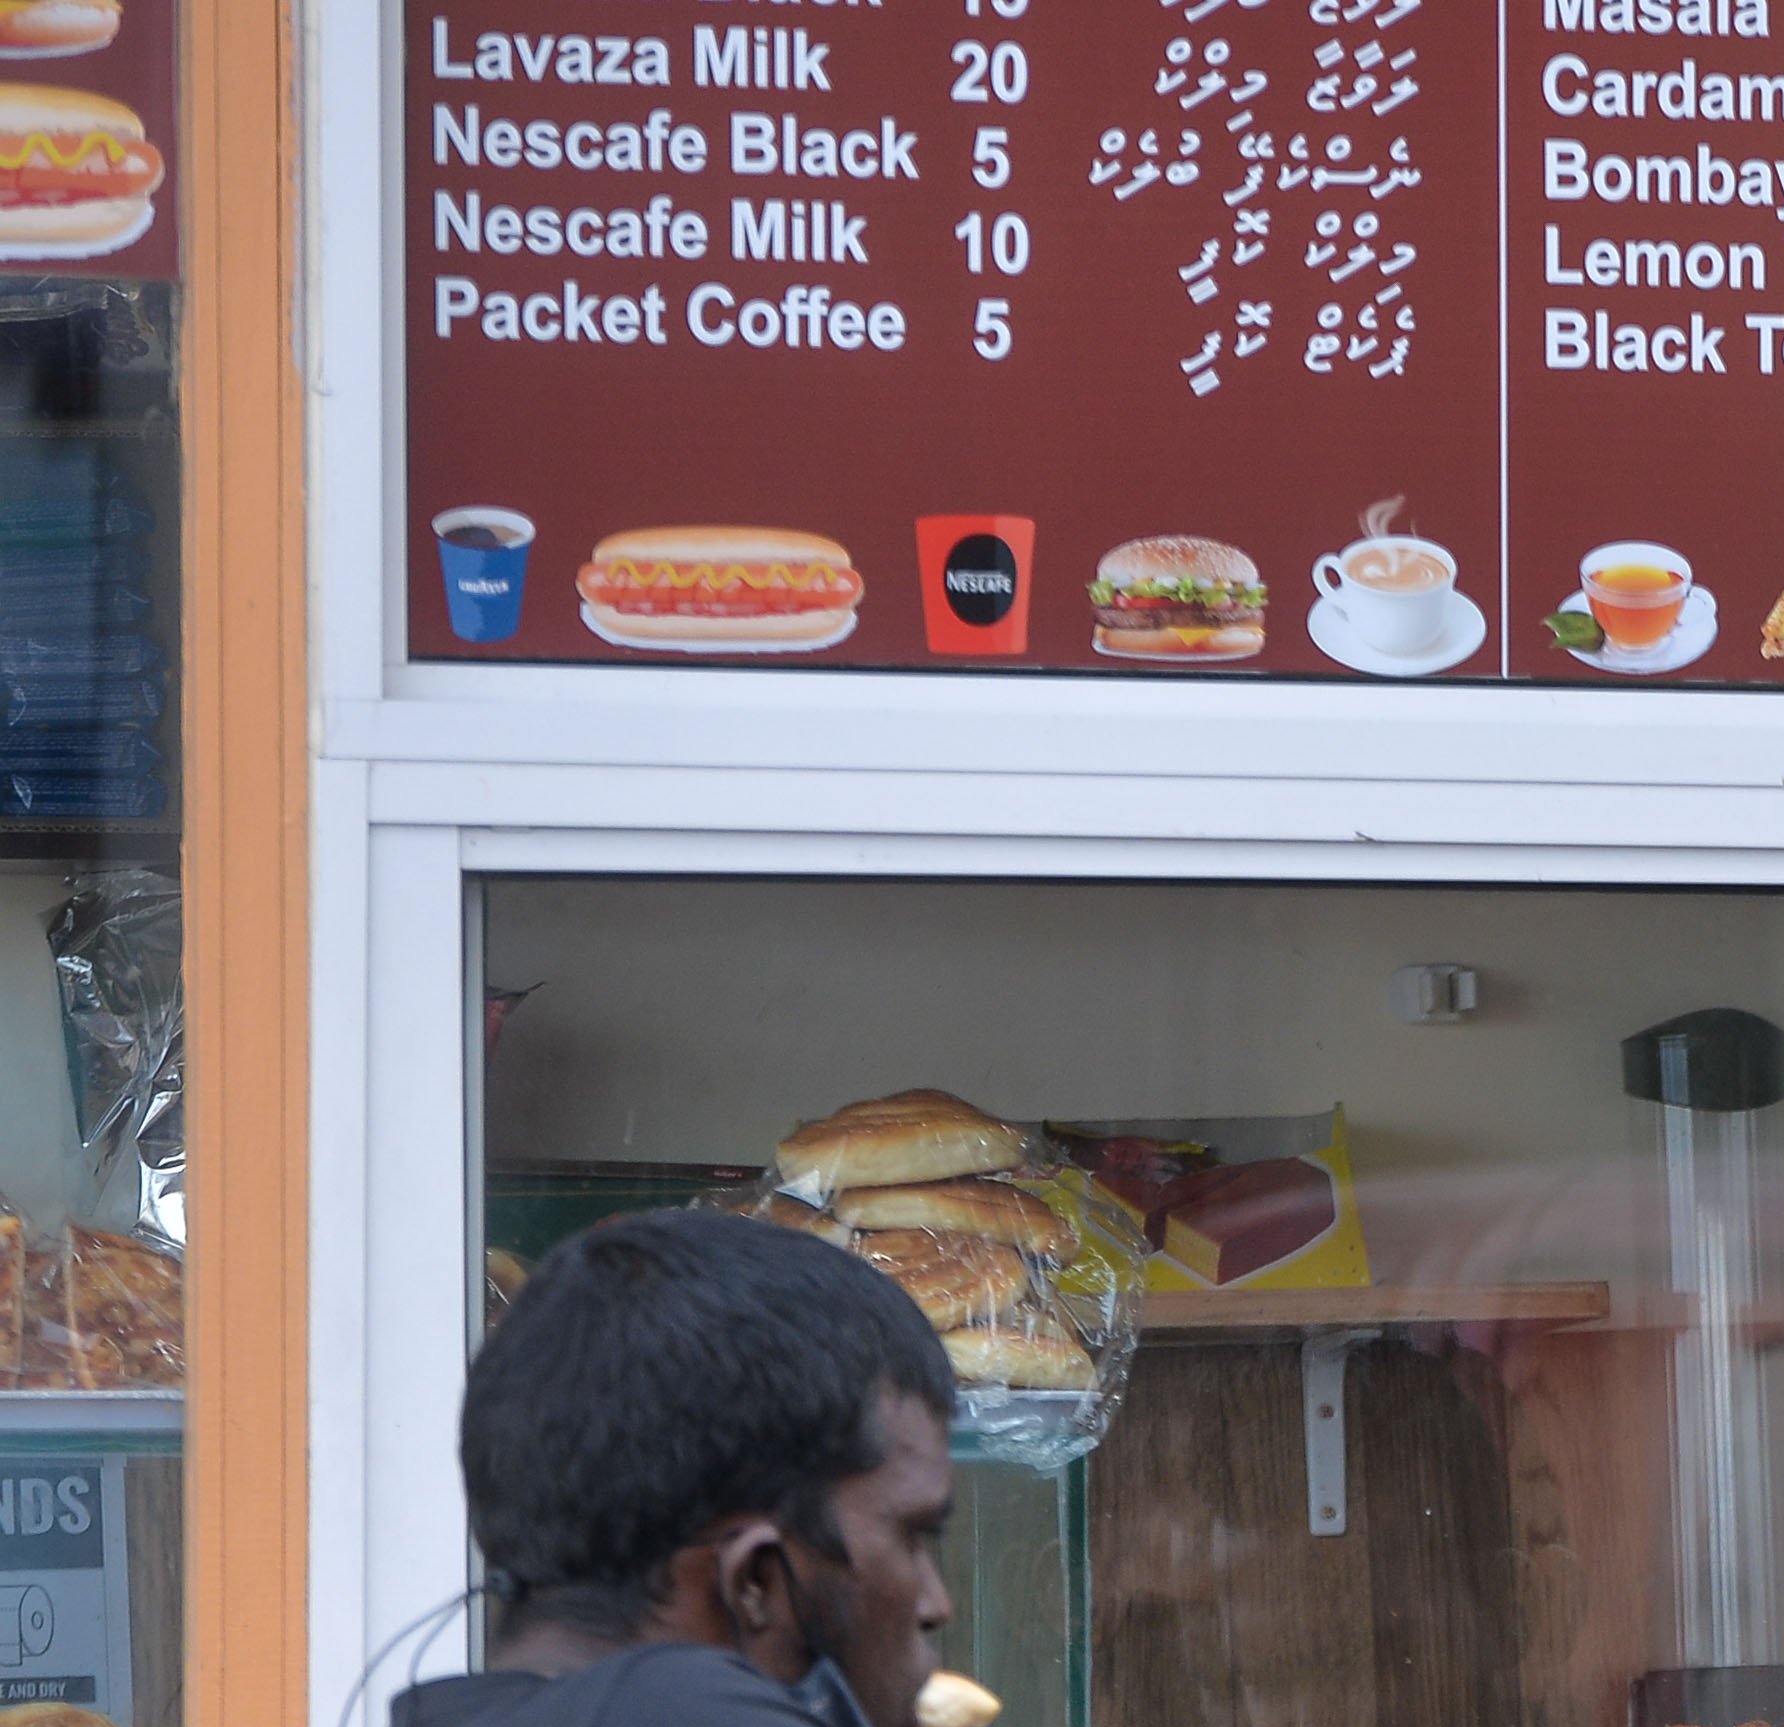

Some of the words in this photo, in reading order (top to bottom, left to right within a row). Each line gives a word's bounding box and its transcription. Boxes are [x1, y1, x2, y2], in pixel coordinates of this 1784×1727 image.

[432, 17, 671, 86] Lavaza
[693, 25, 832, 91] Milk
[950, 40, 1029, 104] 20
[1543, 0, 1770, 38] Masala
[433, 104, 708, 174] Nescafe
[730, 112, 920, 180] Black
[971, 127, 1011, 189] 5
[434, 190, 709, 260] Nescafe
[731, 198, 869, 264] Milk
[954, 212, 1030, 275] 10
[1544, 224, 1766, 290] Lemon
[435, 277, 668, 345] Packet
[686, 283, 907, 351] Coffee
[972, 298, 1013, 361] 5
[1544, 308, 1727, 374] Black
